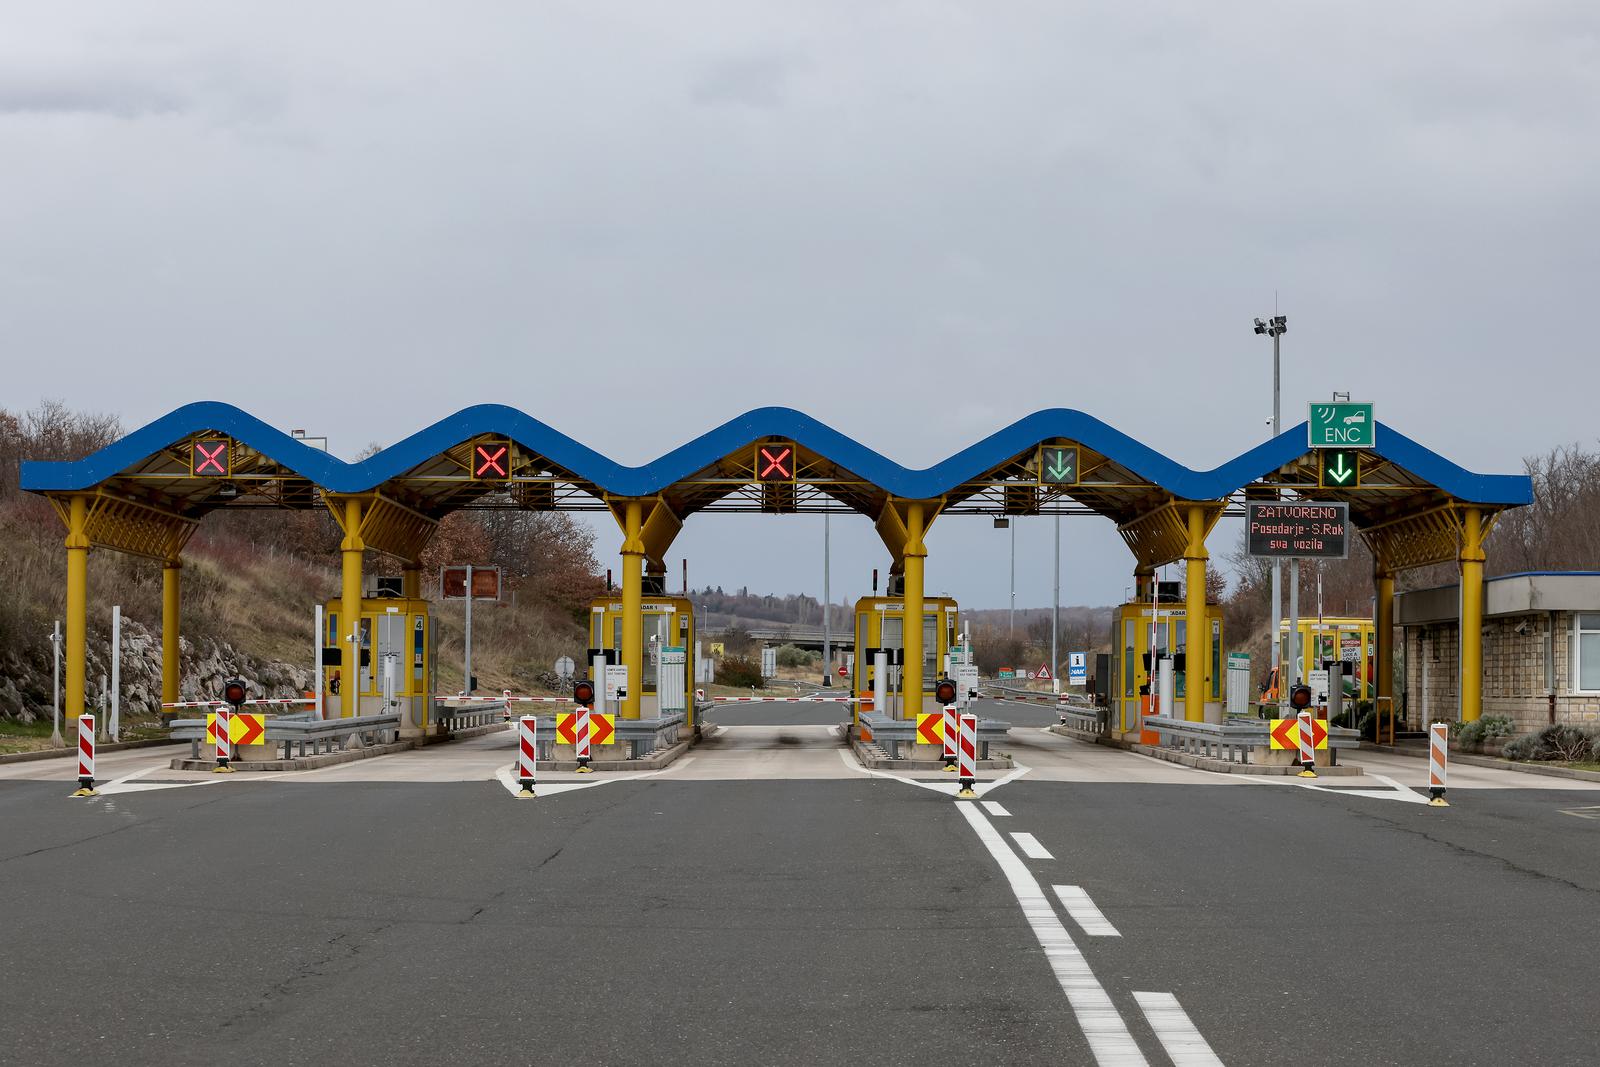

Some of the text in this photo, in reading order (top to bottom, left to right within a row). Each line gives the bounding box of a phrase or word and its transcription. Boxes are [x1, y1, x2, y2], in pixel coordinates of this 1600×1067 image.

[1325, 428, 1361, 442] ENC
[1257, 506, 1337, 519] ZATVORENO
[1270, 538, 1323, 550] sva vozila
[415, 620, 423, 630] 4
[1368, 647, 1373, 656] 5
